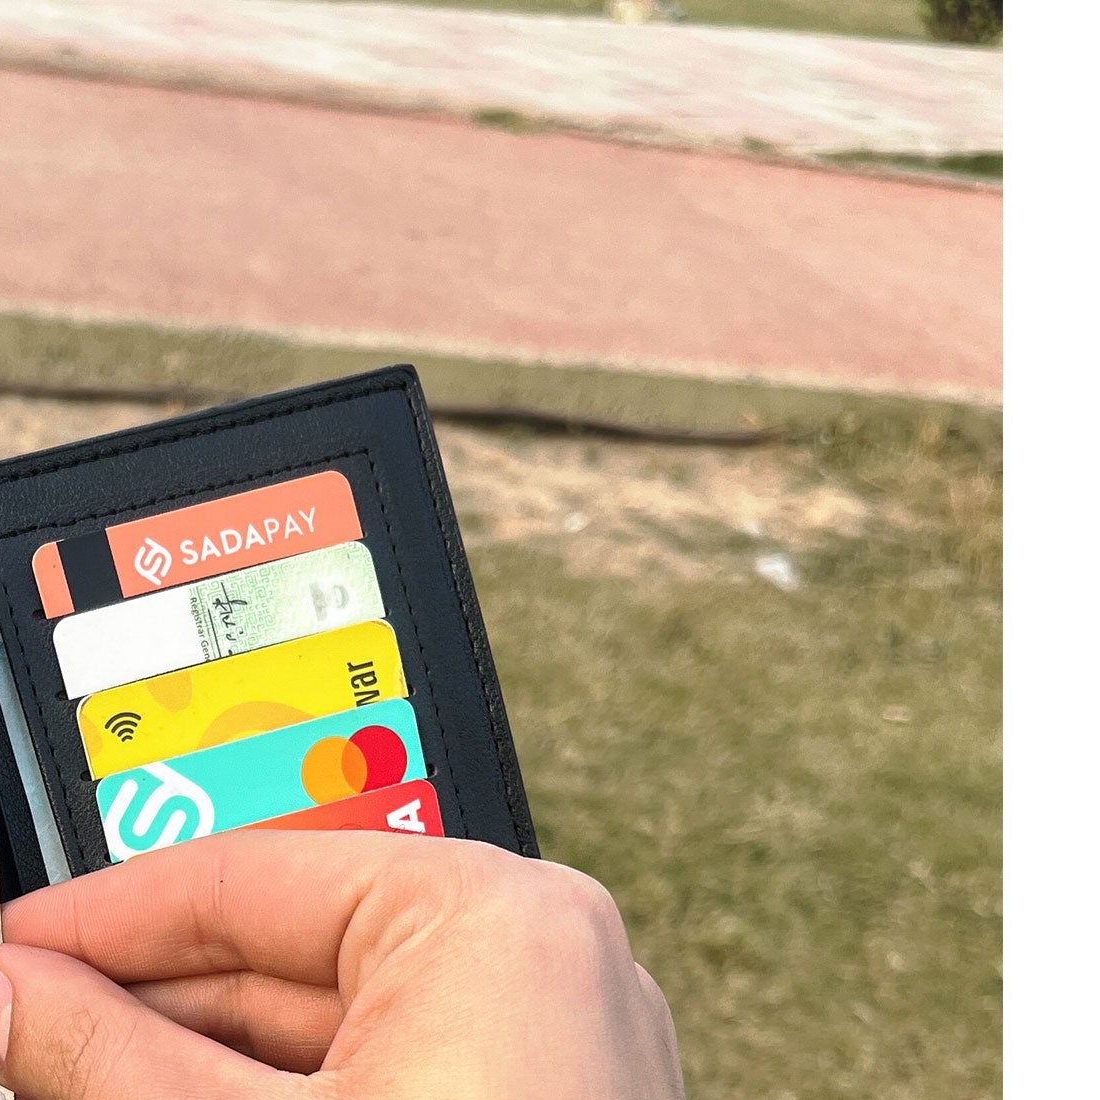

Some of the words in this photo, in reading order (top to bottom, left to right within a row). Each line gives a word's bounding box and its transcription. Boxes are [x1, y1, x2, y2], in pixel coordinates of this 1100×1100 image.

[180, 506, 316, 566] SADAPAY
[190, 597, 205, 638] Registrar
[200, 640, 211, 661] Gen
